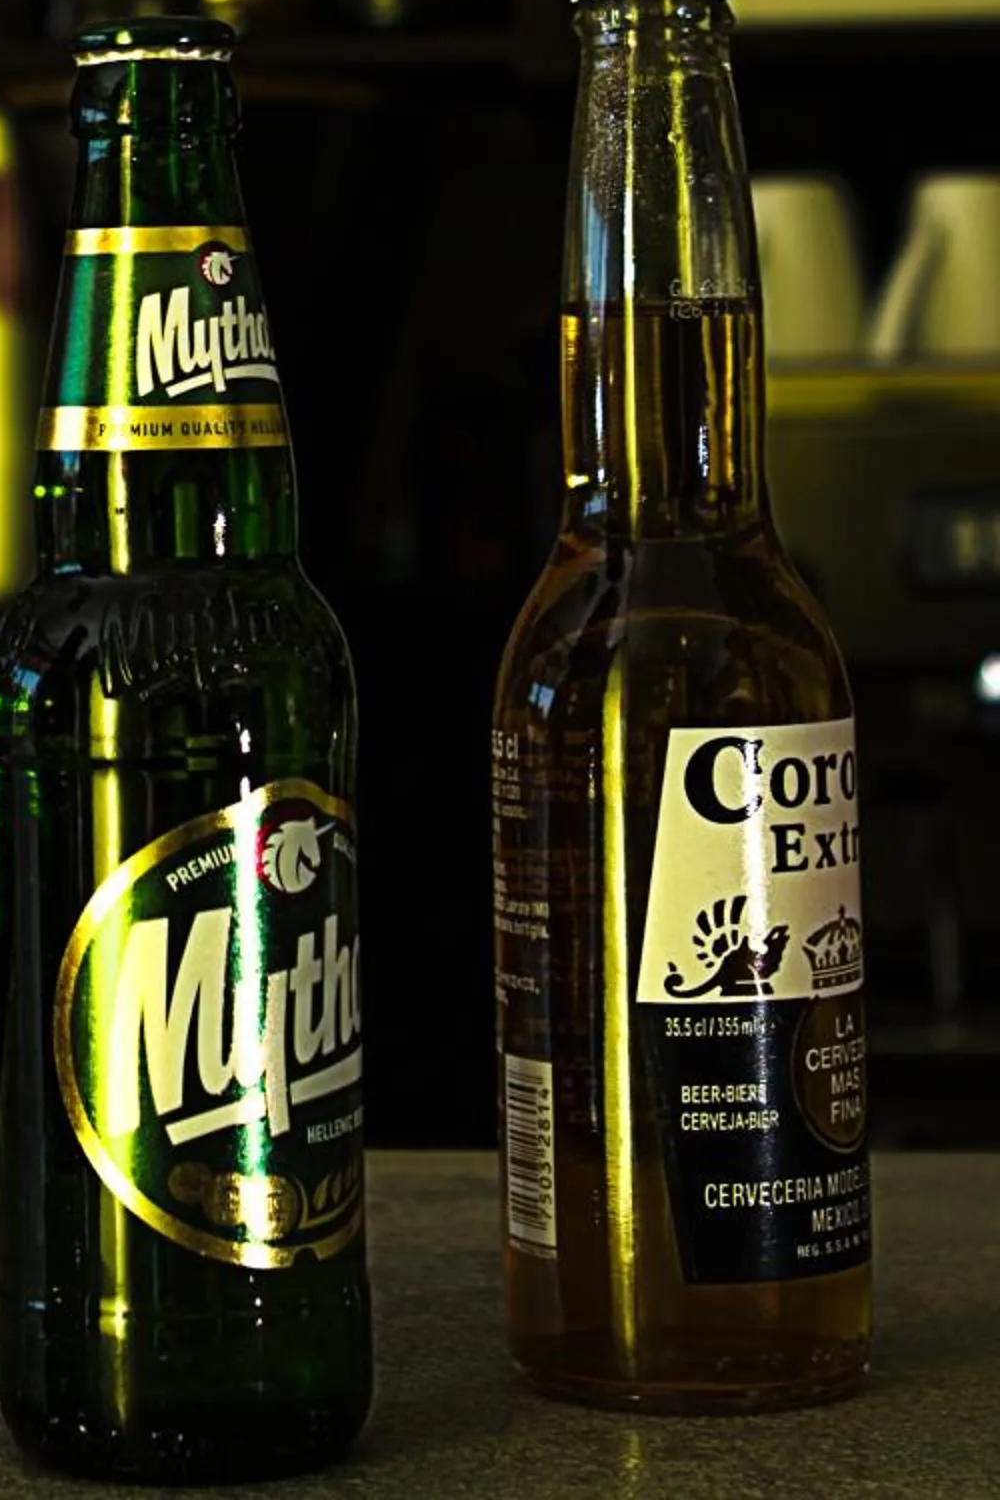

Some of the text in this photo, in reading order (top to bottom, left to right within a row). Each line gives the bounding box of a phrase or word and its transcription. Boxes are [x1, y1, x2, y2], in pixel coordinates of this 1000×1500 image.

[166, 843, 238, 893] PREMIU
[834, 1012, 855, 1039] LA
[703, 1175, 824, 1211] CERVECERIA
